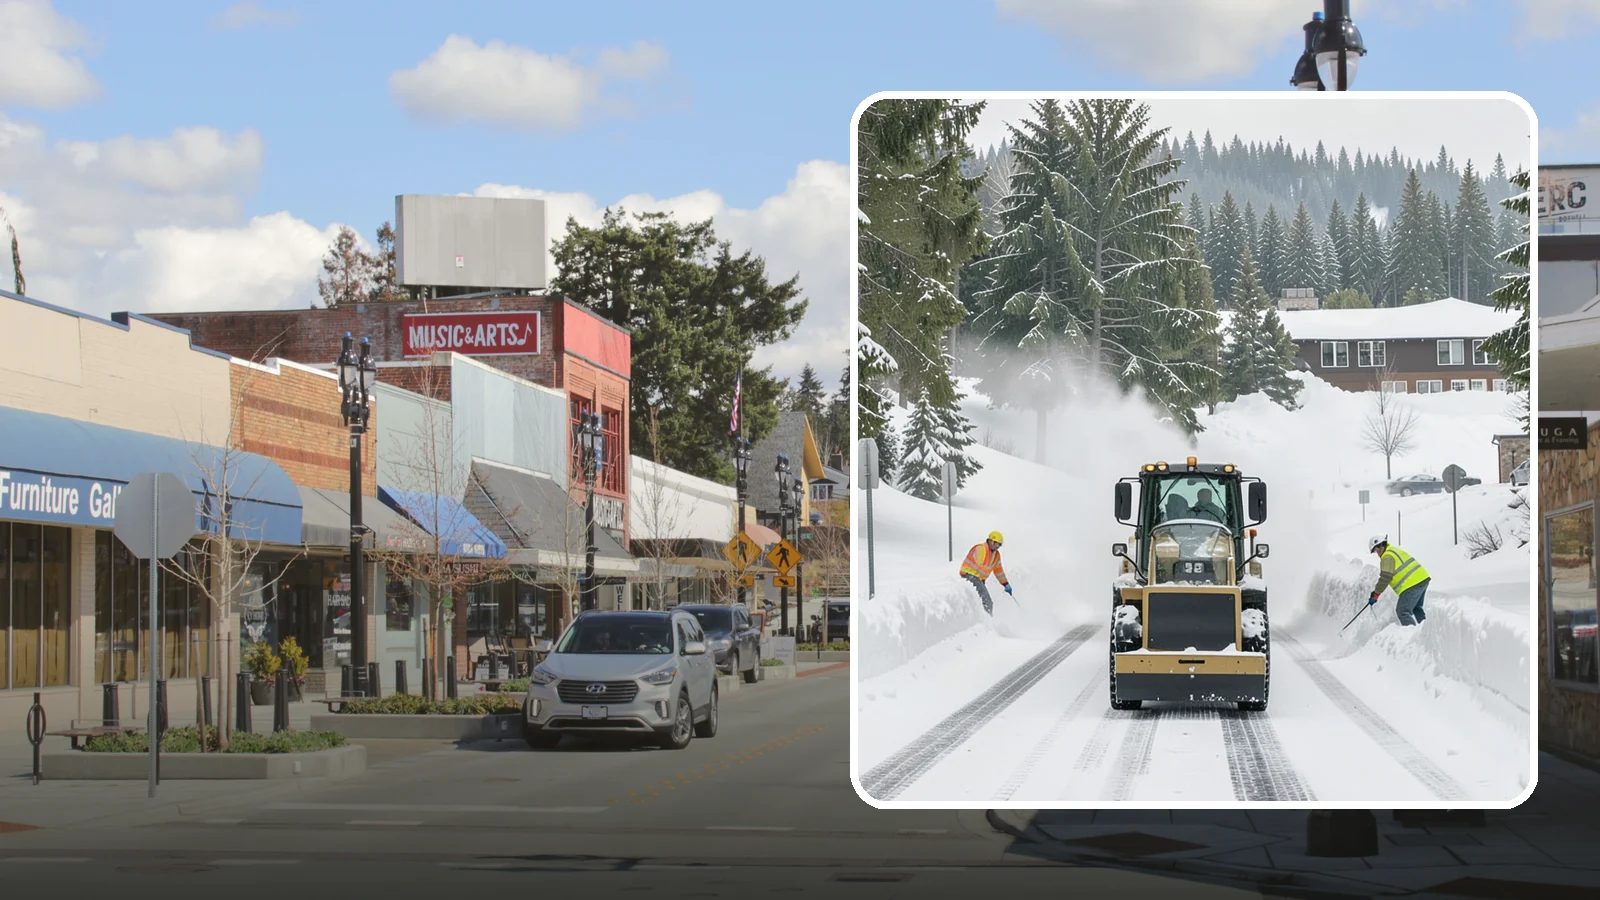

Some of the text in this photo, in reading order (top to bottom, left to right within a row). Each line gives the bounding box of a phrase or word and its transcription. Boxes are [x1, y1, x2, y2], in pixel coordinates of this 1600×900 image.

[1540, 427, 1577, 437] UGA
[0, 471, 122, 519] Furniture Gal
[453, 563, 479, 574] SUSHI
